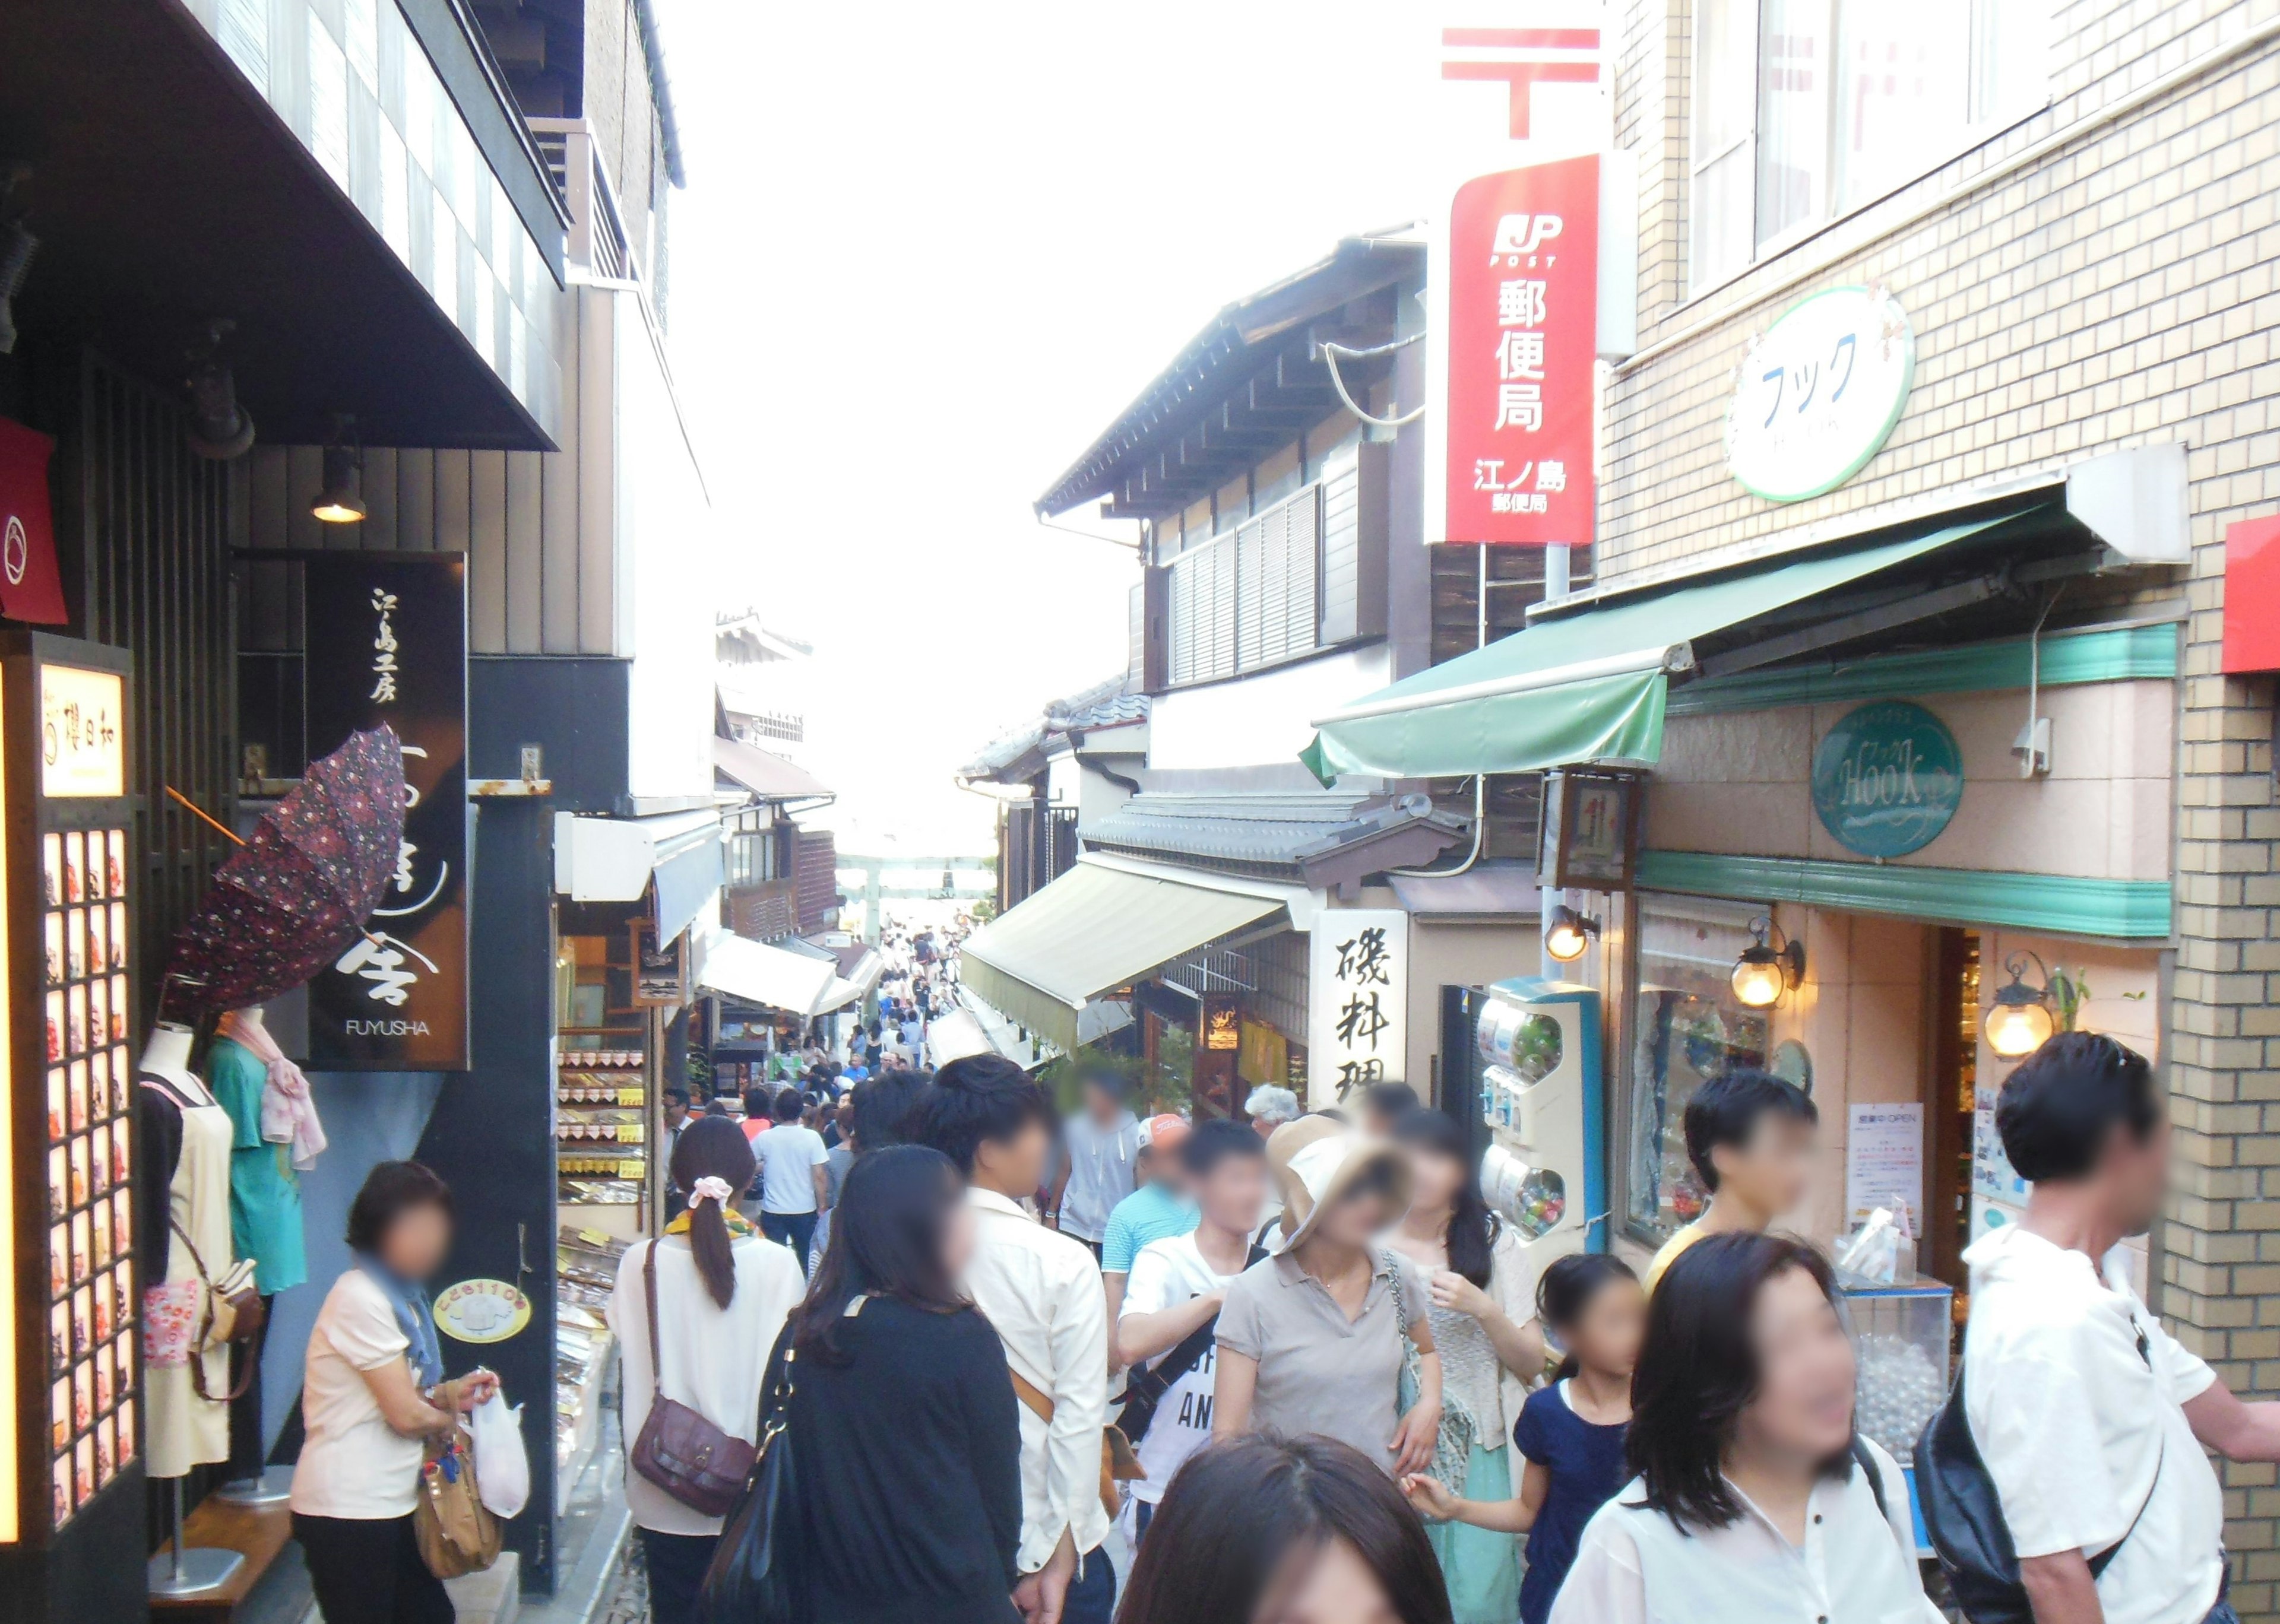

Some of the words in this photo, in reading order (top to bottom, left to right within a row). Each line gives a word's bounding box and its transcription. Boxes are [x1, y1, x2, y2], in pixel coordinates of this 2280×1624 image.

[1489, 255, 1557, 268] POST
[1494, 278, 1547, 432] 郵便局
[1762, 332, 1857, 429] フック
[1473, 458, 1568, 492] 江ノ島
[1491, 492, 1548, 513] 郵便局
[346, 1020, 430, 1036] FUYUSHA
[1888, 1113, 1917, 1124] OPEN
